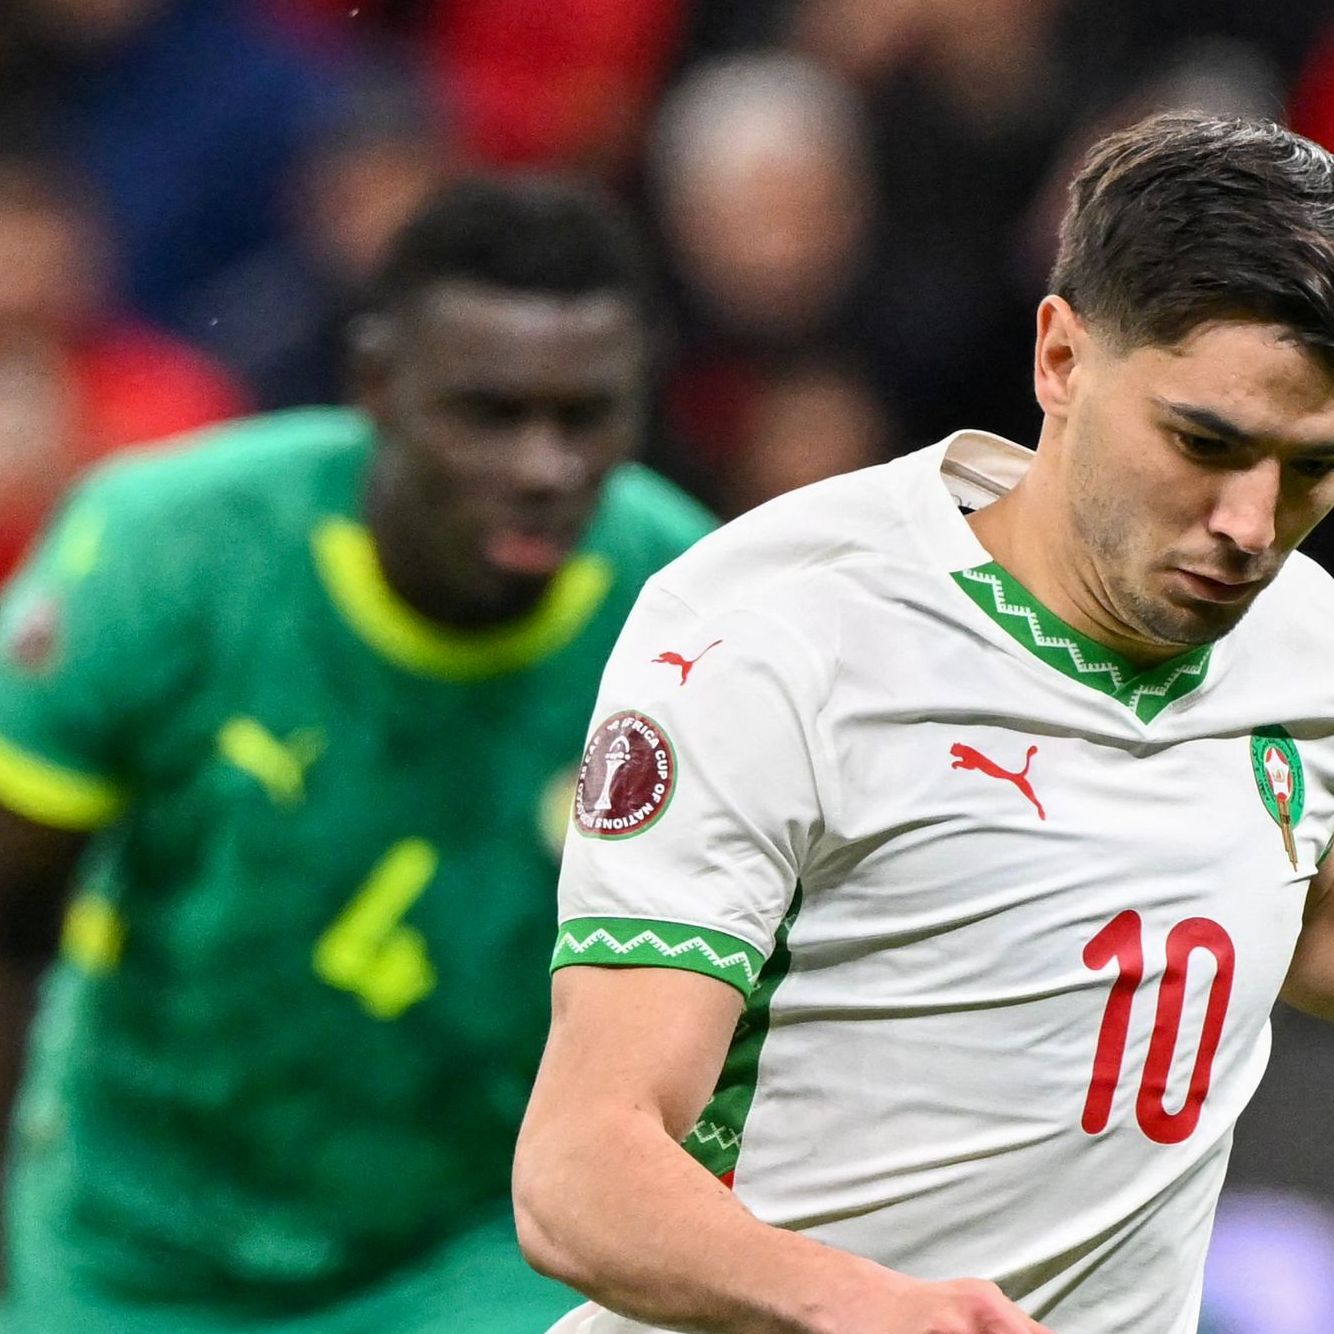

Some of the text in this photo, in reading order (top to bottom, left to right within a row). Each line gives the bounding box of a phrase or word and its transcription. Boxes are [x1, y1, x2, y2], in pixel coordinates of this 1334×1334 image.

[606, 717, 660, 749] AFRICA
[655, 750, 669, 780] CUP
[651, 783, 666, 804] OF
[594, 802, 655, 830] NATIONS
[311, 836, 438, 1021] 6
[1081, 908, 1236, 1145] 10
